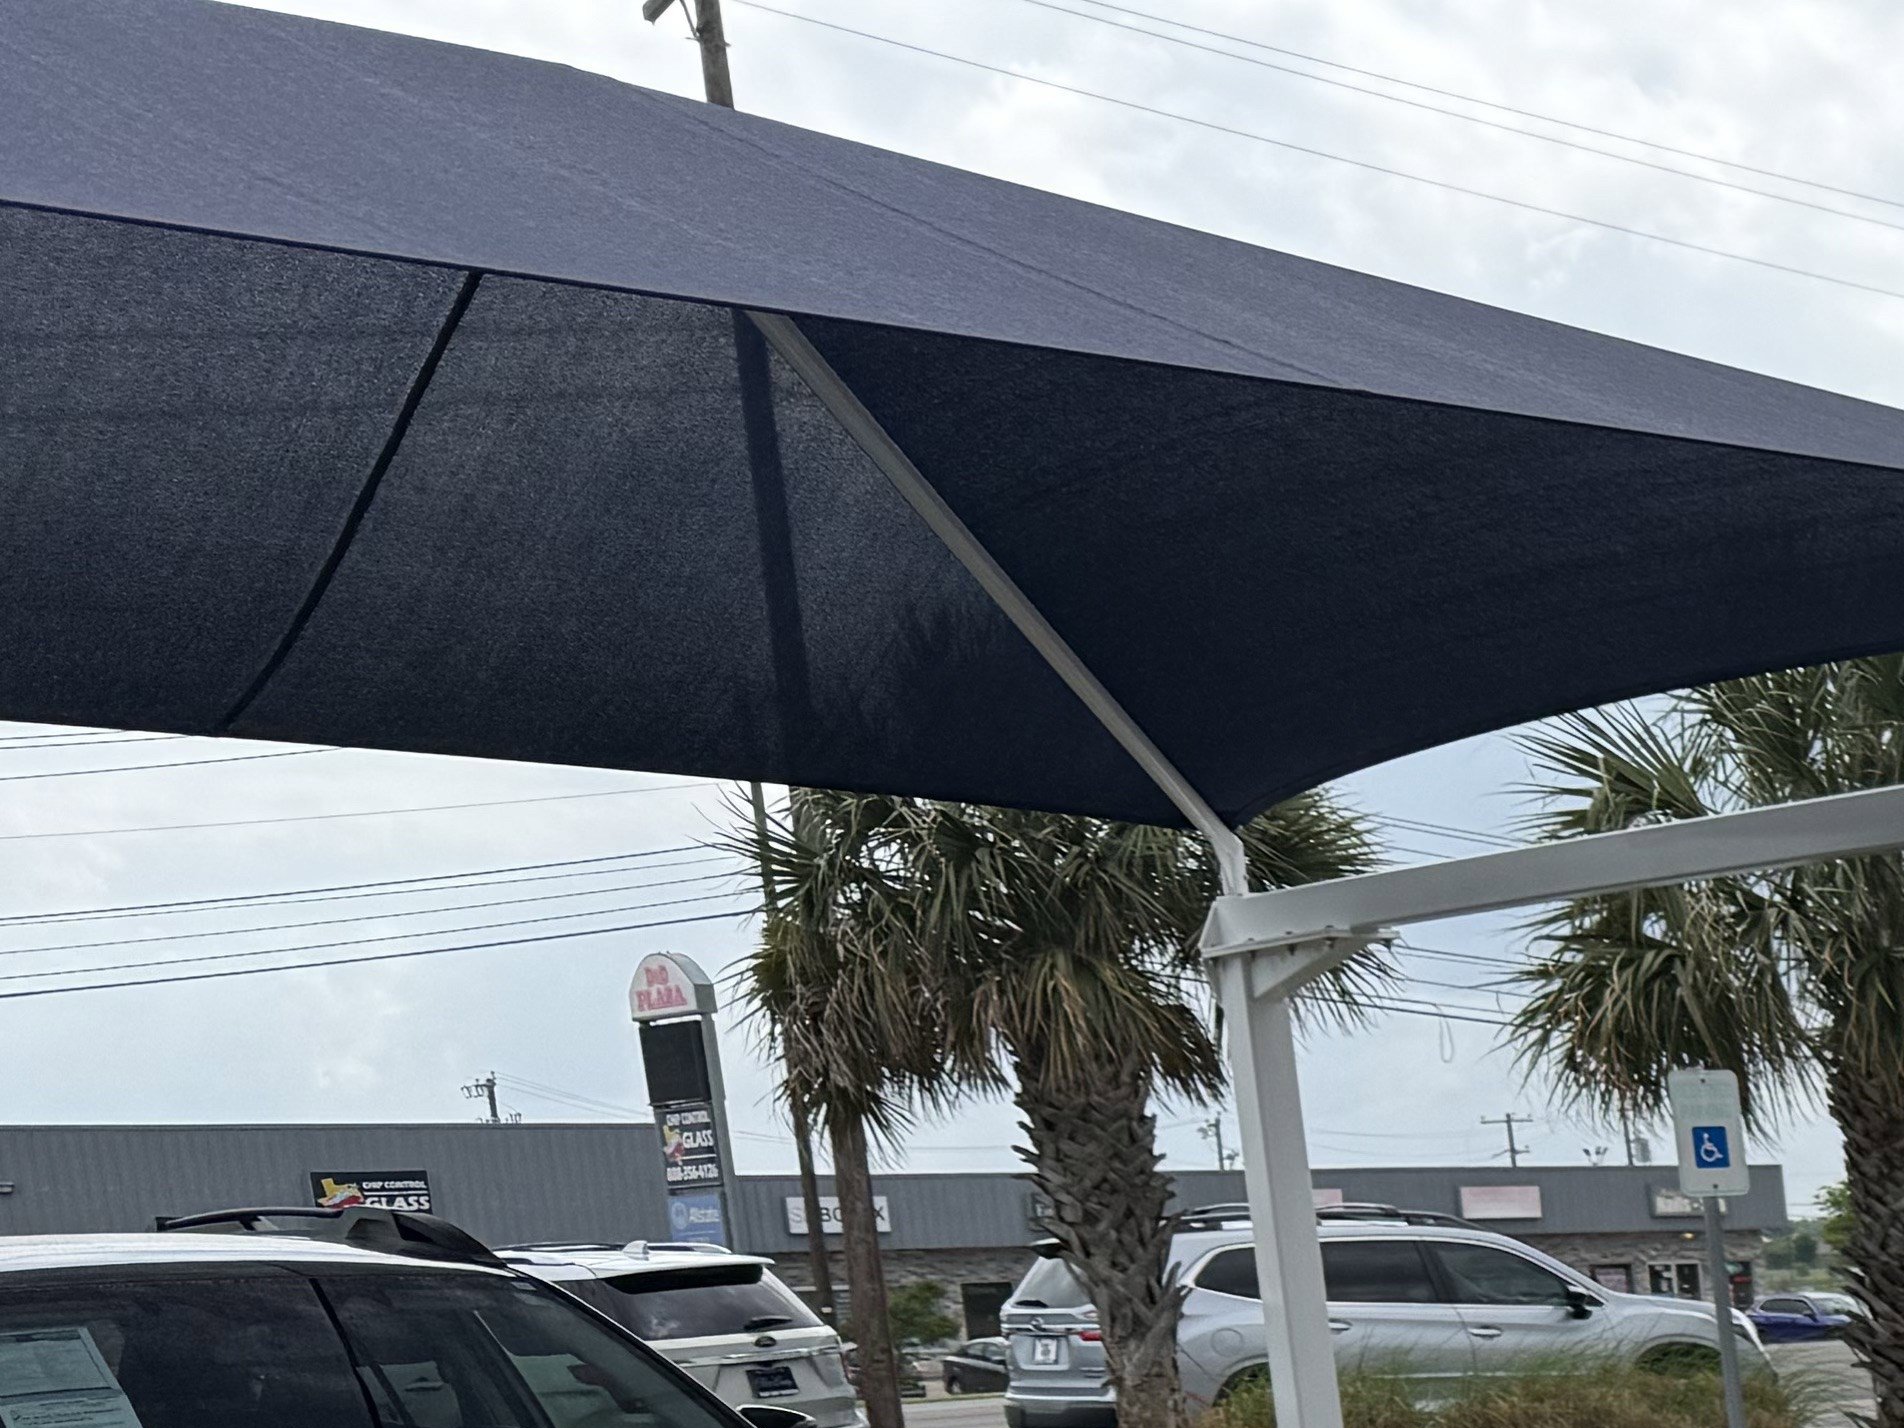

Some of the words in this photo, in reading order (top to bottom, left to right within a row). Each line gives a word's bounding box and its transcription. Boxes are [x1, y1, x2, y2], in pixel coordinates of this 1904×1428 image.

[635, 984, 688, 1012] PLAZA
[682, 1129, 714, 1149] GLASS
[365, 1196, 431, 1211] GLASS
